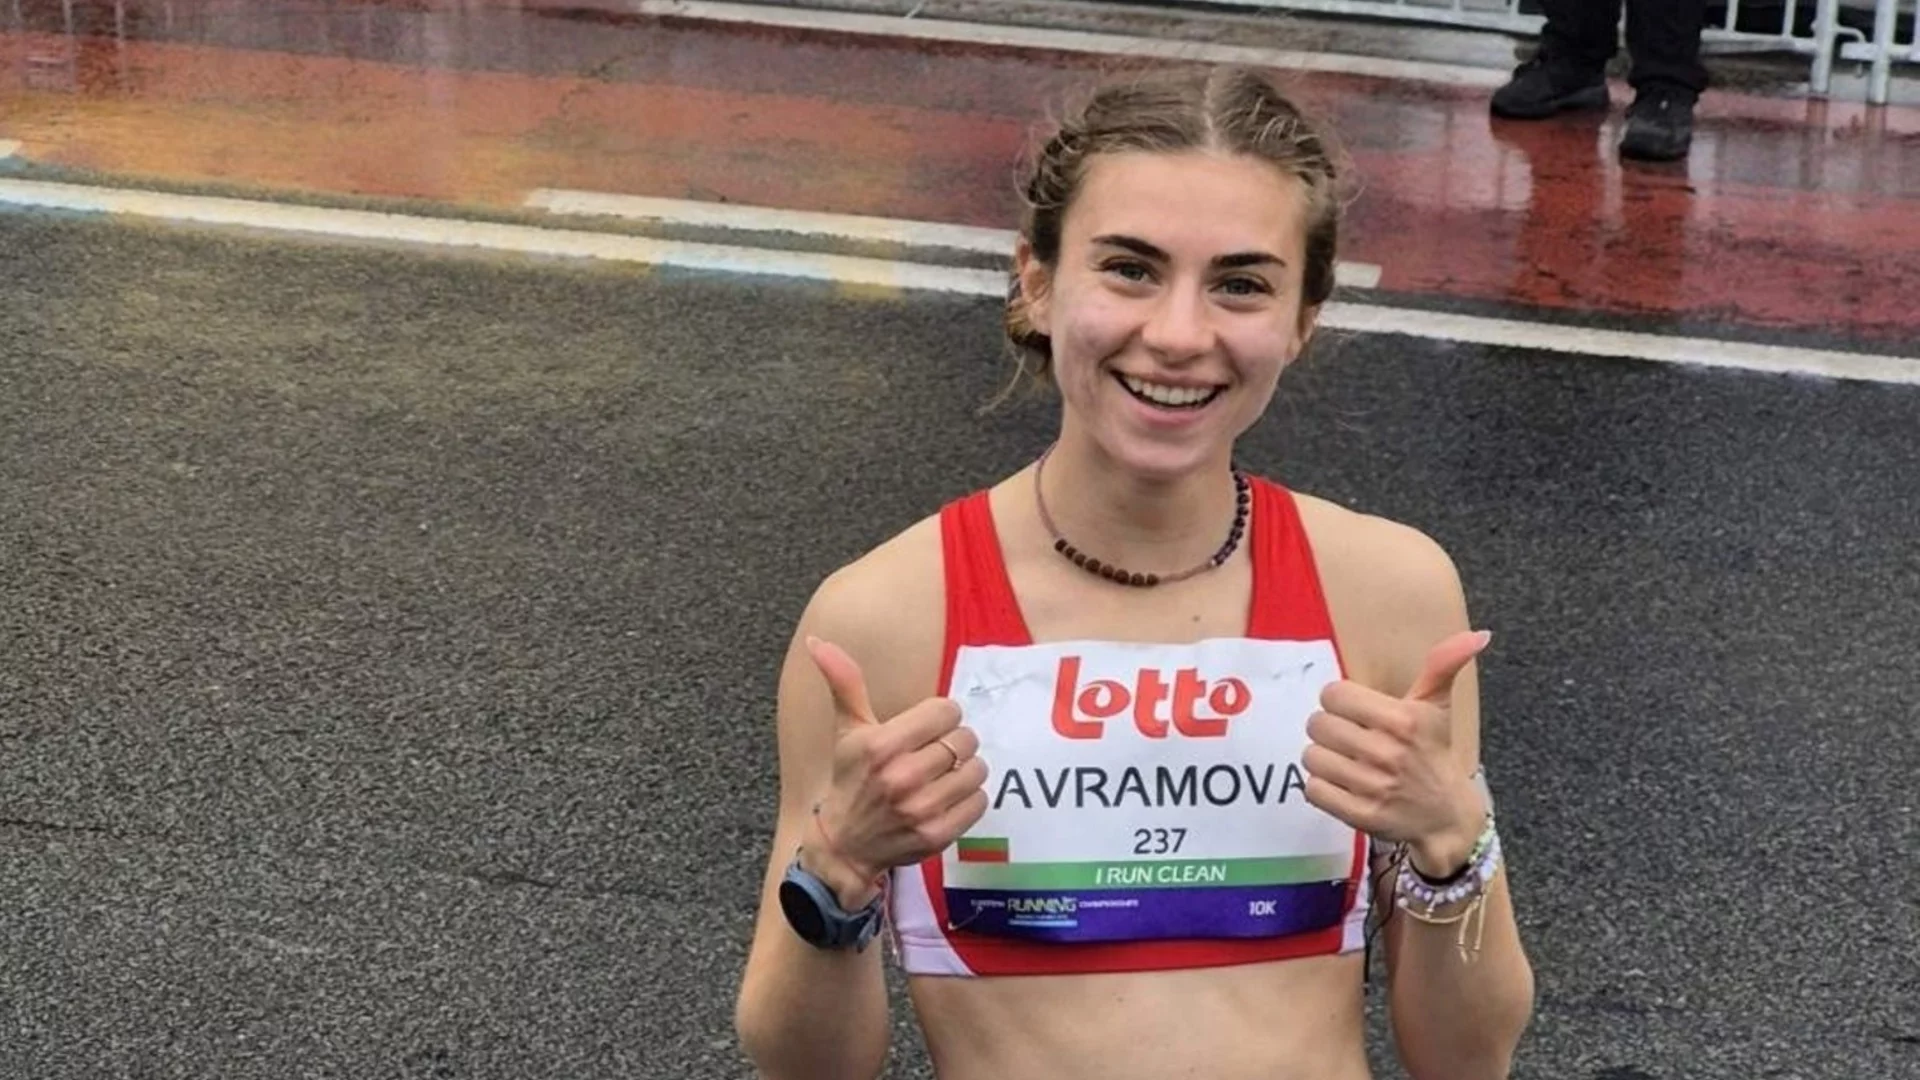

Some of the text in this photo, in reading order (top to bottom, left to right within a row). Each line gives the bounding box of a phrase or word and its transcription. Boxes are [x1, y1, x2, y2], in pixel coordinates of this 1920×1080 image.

[994, 763, 1311, 810] AVRAMOVA
[1133, 828, 1187, 854] 237
[1095, 864, 1228, 885] I RUN CLEAN
[1248, 900, 1277, 916] 10K
